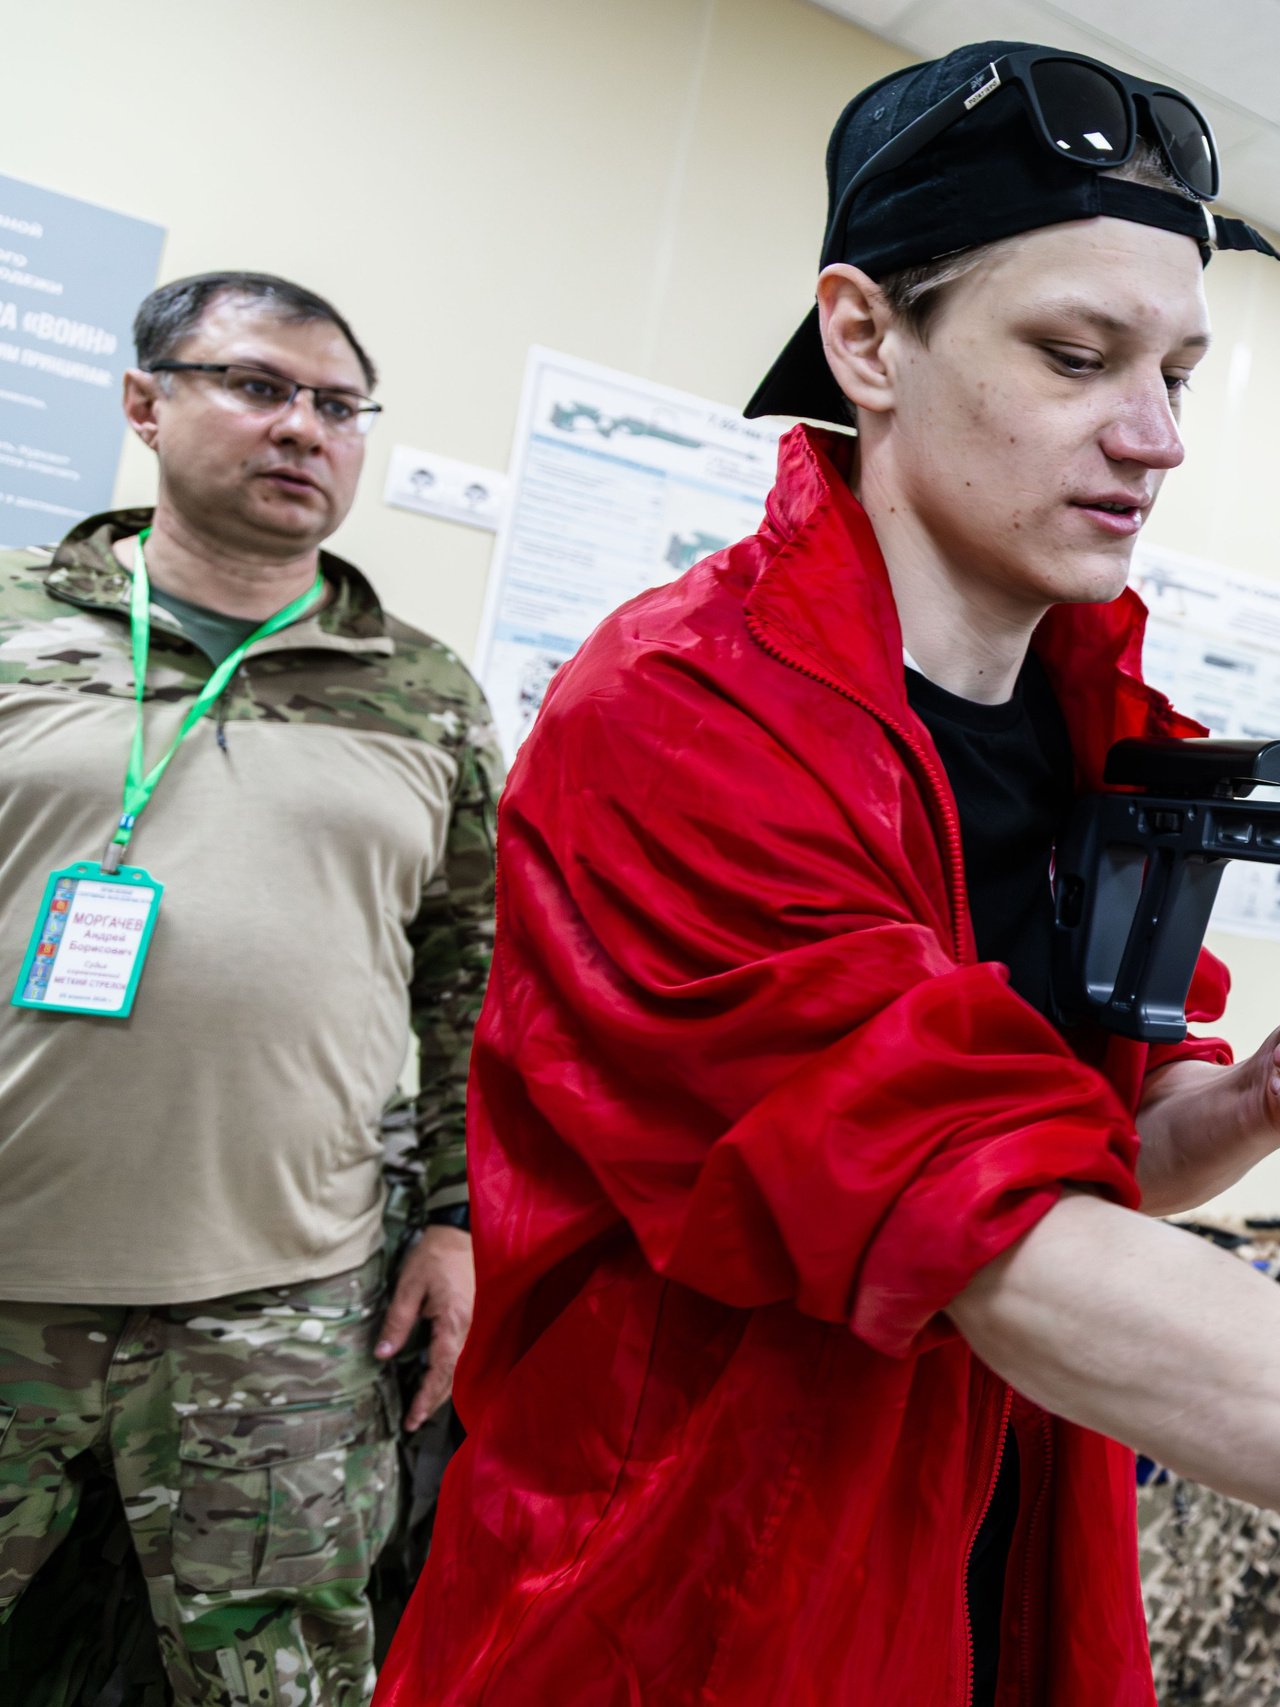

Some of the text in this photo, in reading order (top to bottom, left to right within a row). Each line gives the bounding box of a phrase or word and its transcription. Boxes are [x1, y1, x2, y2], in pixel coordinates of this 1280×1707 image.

[22, 311, 117, 355] «ВОИН»
[73, 912, 144, 931] МОРГАЧЕВ
[84, 929, 126, 942] Андрей
[69, 940, 132, 956] Борисович
